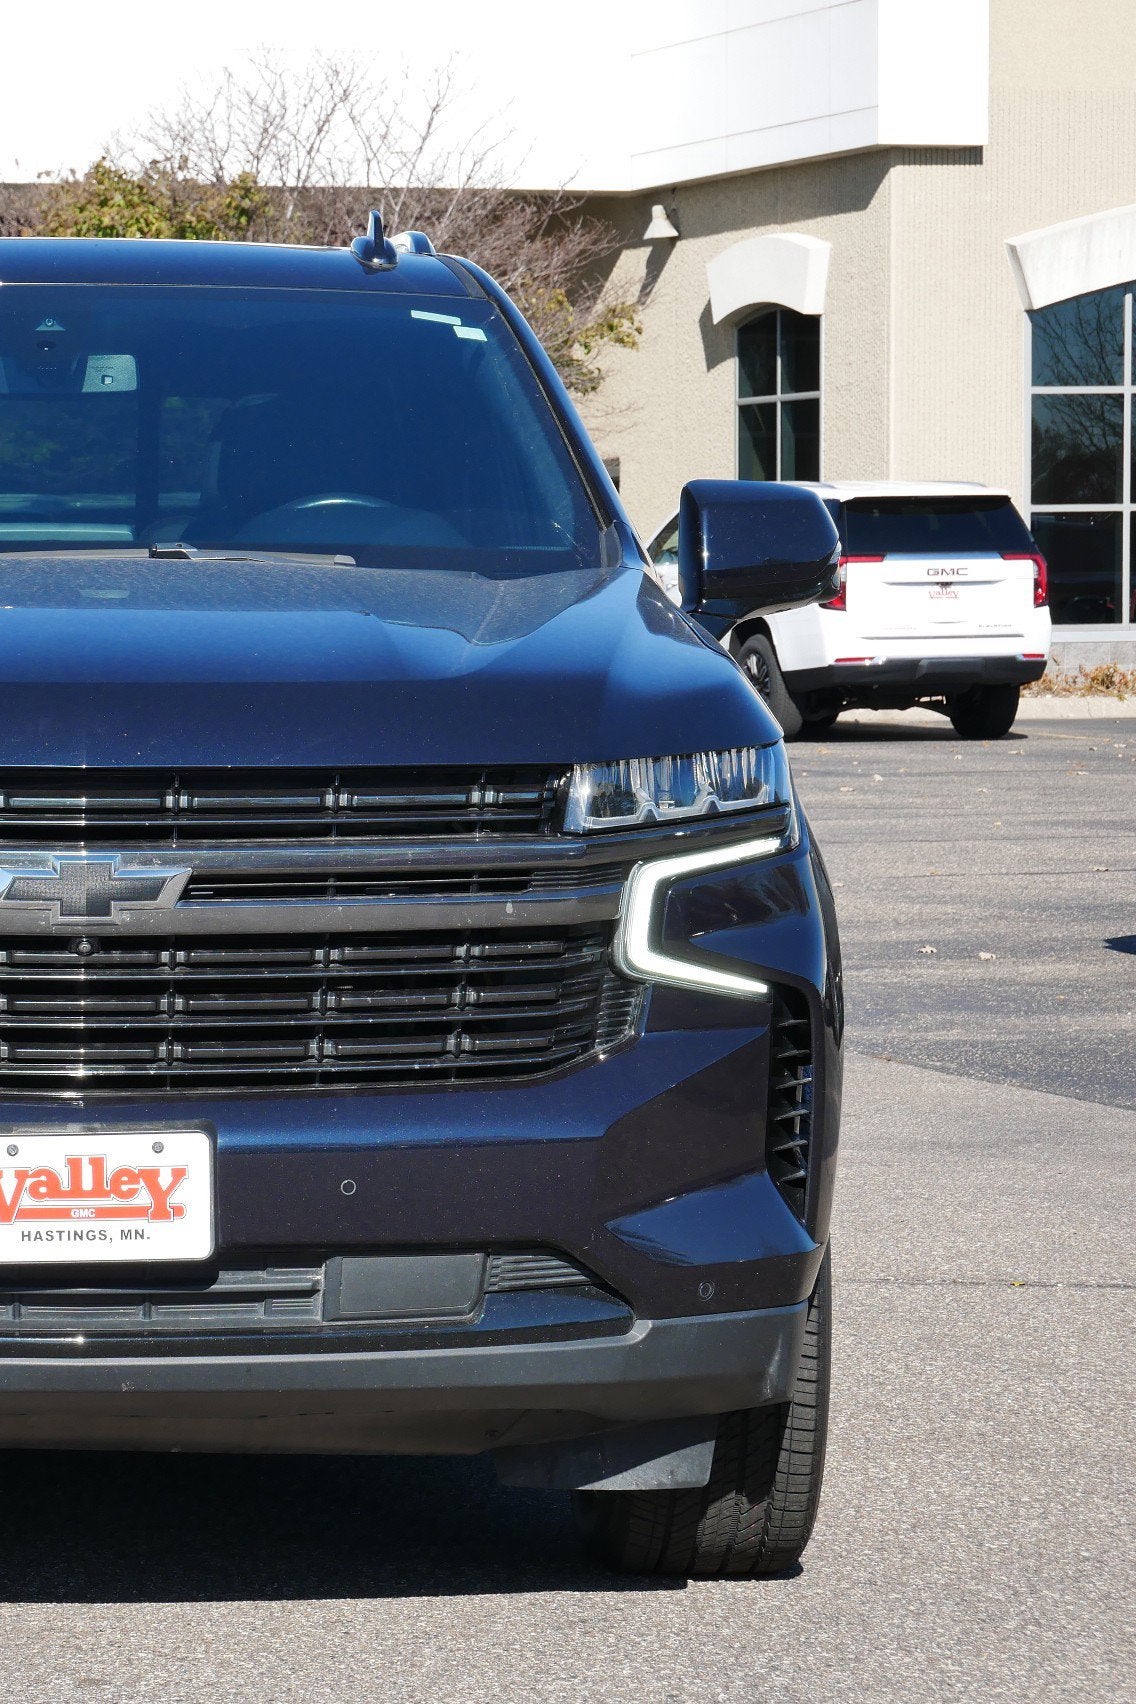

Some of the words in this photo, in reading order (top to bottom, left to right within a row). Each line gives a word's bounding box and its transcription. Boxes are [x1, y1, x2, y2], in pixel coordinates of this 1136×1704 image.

[927, 567, 968, 576] GMC
[70, 1208, 96, 1218] GMC
[21, 1229, 113, 1243] HASTINGS,
[120, 1229, 151, 1240] MN.
